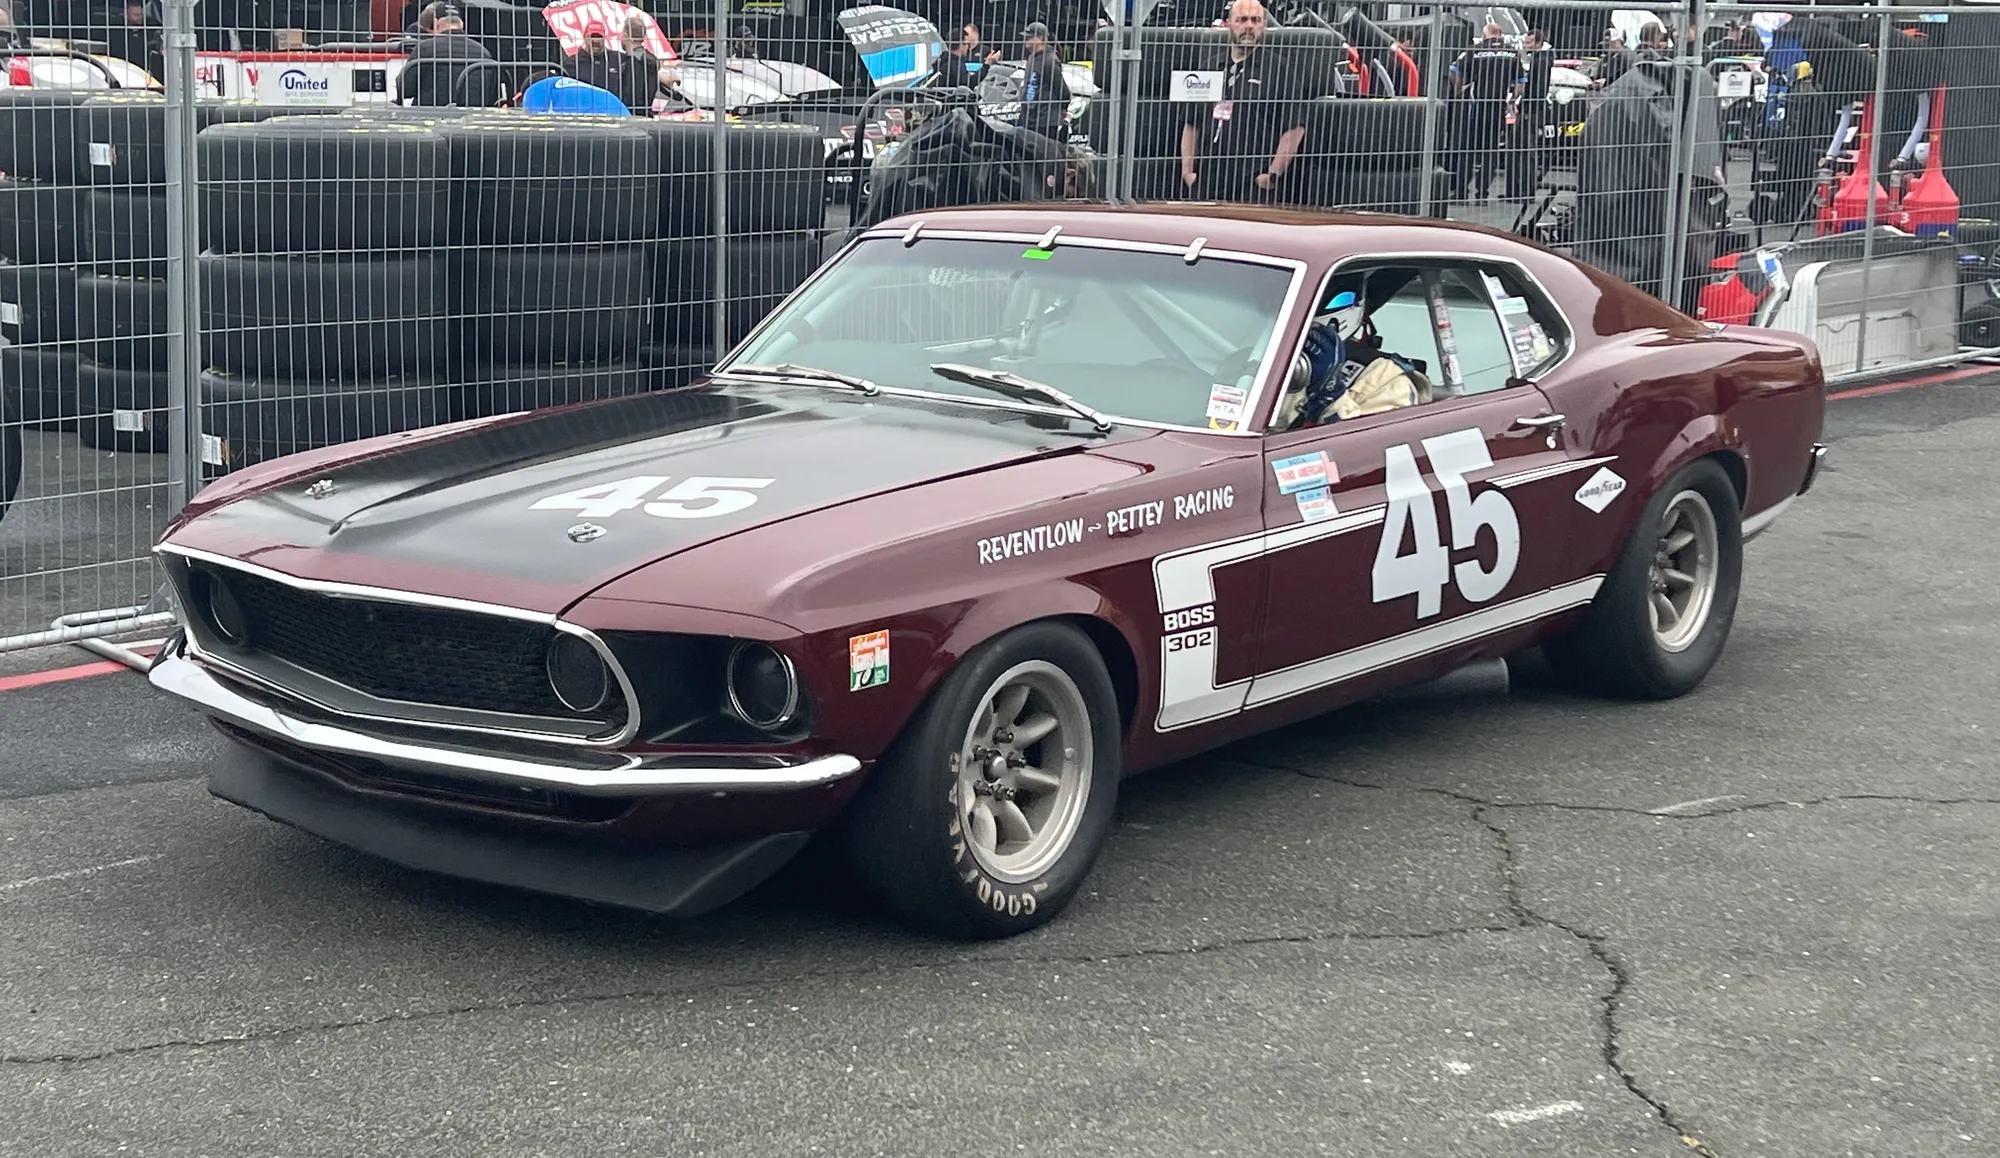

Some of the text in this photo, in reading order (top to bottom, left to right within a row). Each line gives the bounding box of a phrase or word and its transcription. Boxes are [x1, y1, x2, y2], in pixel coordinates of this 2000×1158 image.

[284, 76, 329, 90] United
[1901, 212, 1910, 224] 3
[527, 475, 777, 519] 45
[977, 517, 1084, 565] REVENTLOW
[1106, 500, 1164, 536] PETTEY
[1173, 485, 1234, 520] RACING
[1371, 426, 1520, 620] 45
[1163, 604, 1215, 632] BOSS
[1168, 631, 1212, 652] 302
